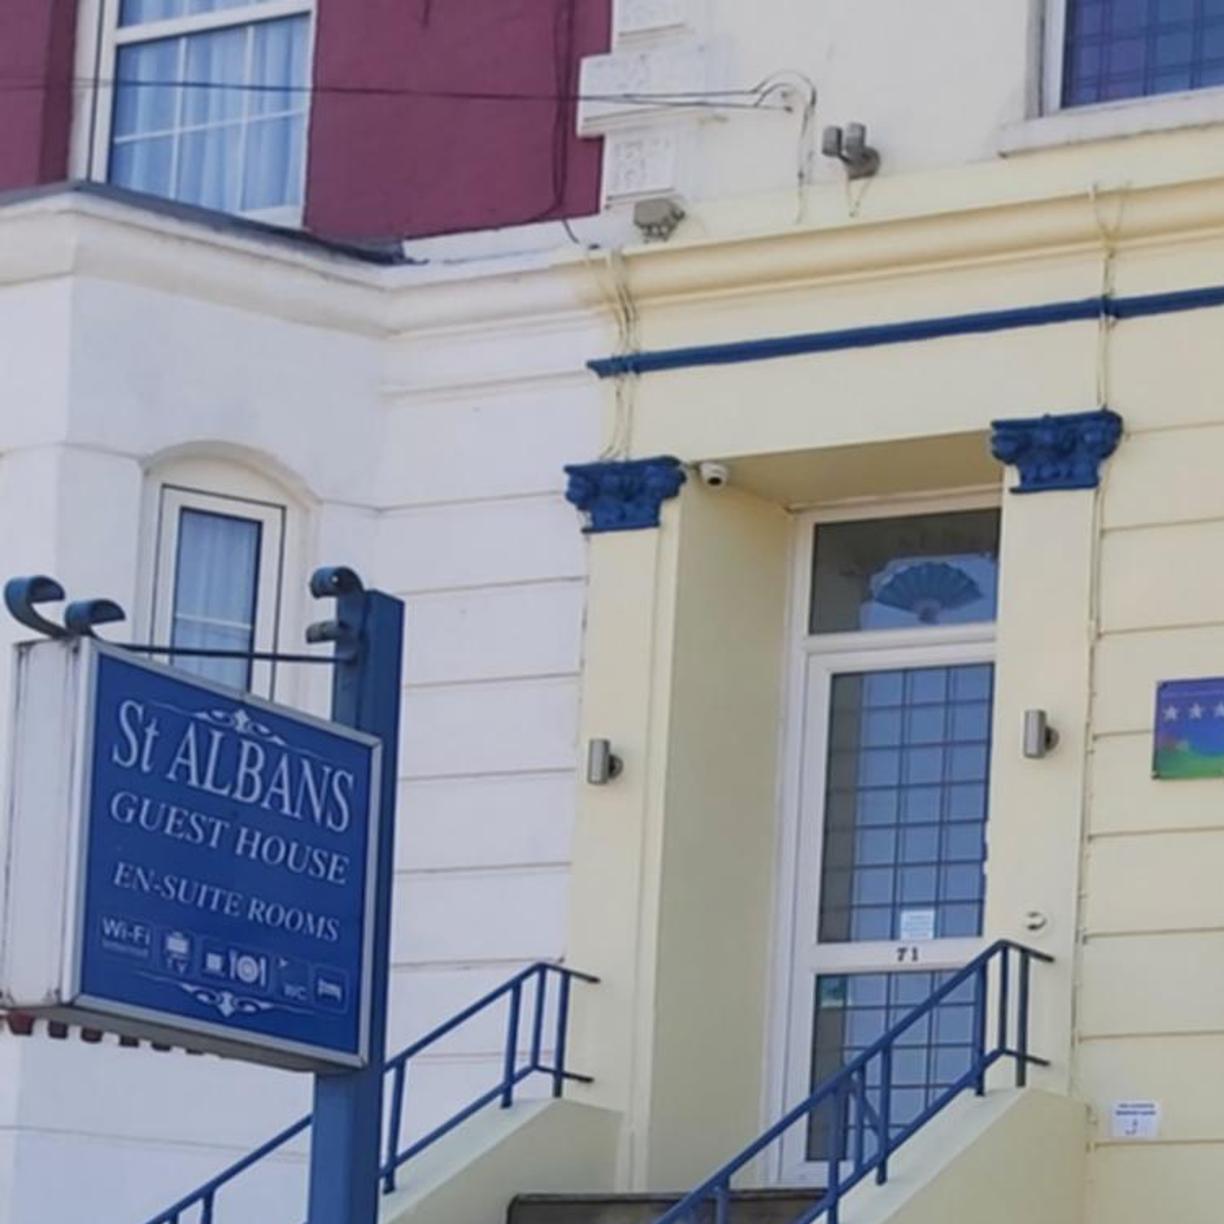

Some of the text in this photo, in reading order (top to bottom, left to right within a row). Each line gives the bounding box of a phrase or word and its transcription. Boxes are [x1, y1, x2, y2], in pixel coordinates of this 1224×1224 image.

[113, 700, 354, 833] St ALBANS
[110, 791, 350, 885] GUEST HOUSE
[102, 916, 151, 946] Wi-Fi
[113, 861, 341, 942] EN-SUITE ROOMS
[896, 947, 919, 962] 71
